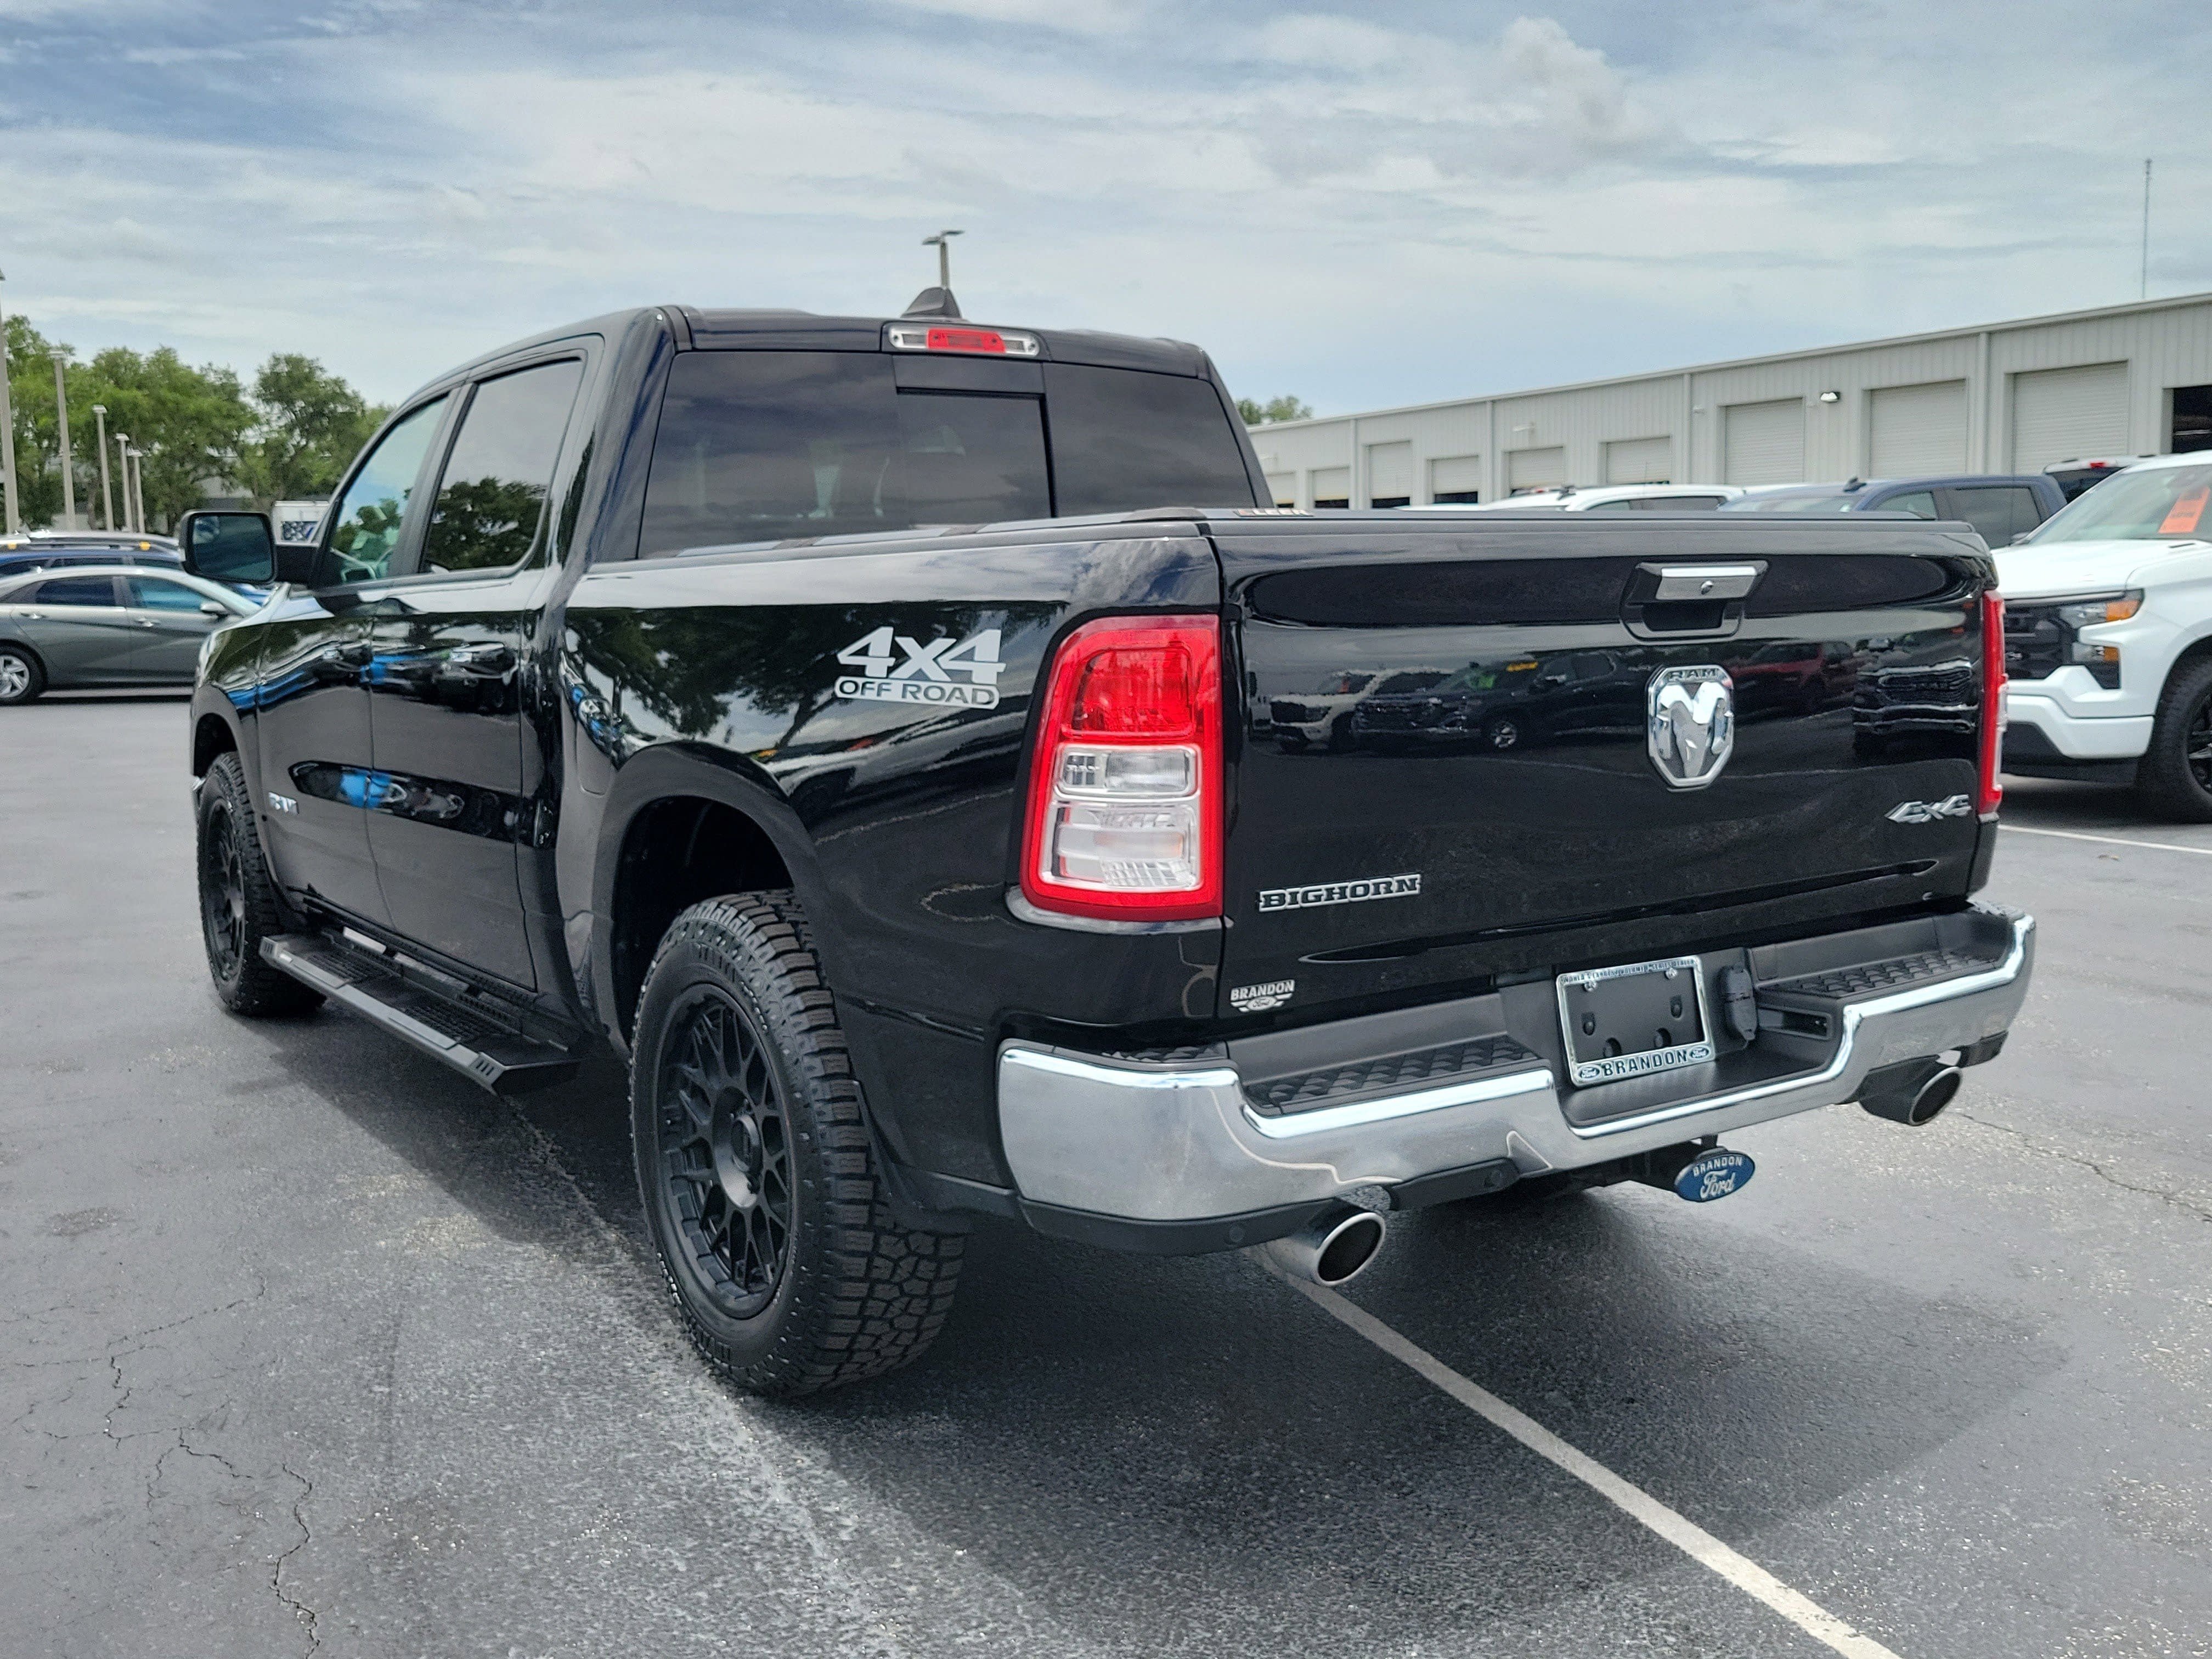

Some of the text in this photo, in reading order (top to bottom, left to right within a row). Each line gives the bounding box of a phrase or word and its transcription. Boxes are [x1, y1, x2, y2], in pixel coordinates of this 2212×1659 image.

[839, 680, 995, 706] OFF ROAD
[1259, 873, 1421, 912] BIGHORN
[1230, 979, 1295, 1001] BRANDON
[1602, 1049, 1688, 1077] BRANDON
[1692, 1155, 1742, 1177] BRANDON
[1700, 1169, 1736, 1199] Ford
